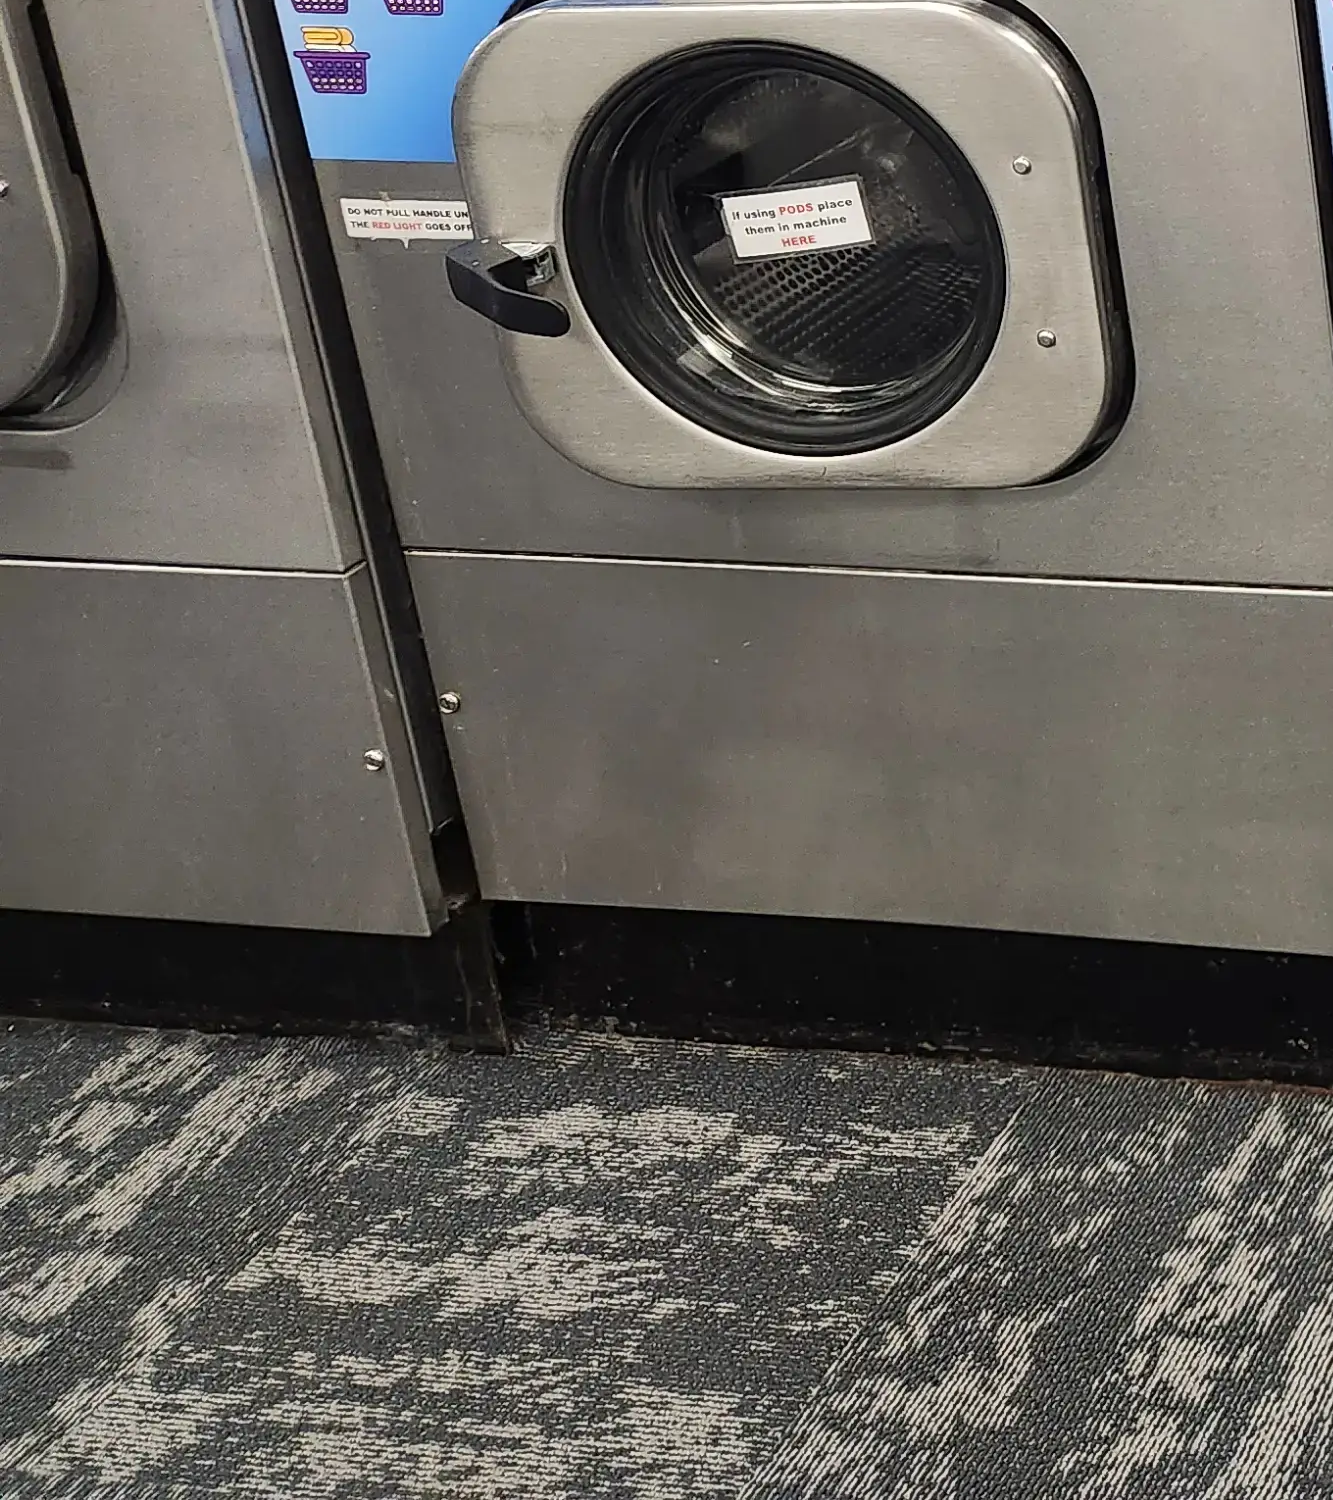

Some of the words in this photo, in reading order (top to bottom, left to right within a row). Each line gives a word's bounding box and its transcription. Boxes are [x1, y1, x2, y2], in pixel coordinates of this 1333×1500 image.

[364, 208, 383, 216] NOT
[413, 210, 451, 218] HANDLE
[732, 211, 740, 220] If
[744, 209, 776, 220] using
[778, 203, 814, 215] PODS
[817, 198, 852, 213] place
[372, 221, 390, 229] RED
[394, 222, 422, 230] LIGHT
[745, 224, 775, 235] them
[778, 222, 790, 232] in
[793, 215, 847, 230] machine
[782, 235, 817, 247] HERE
